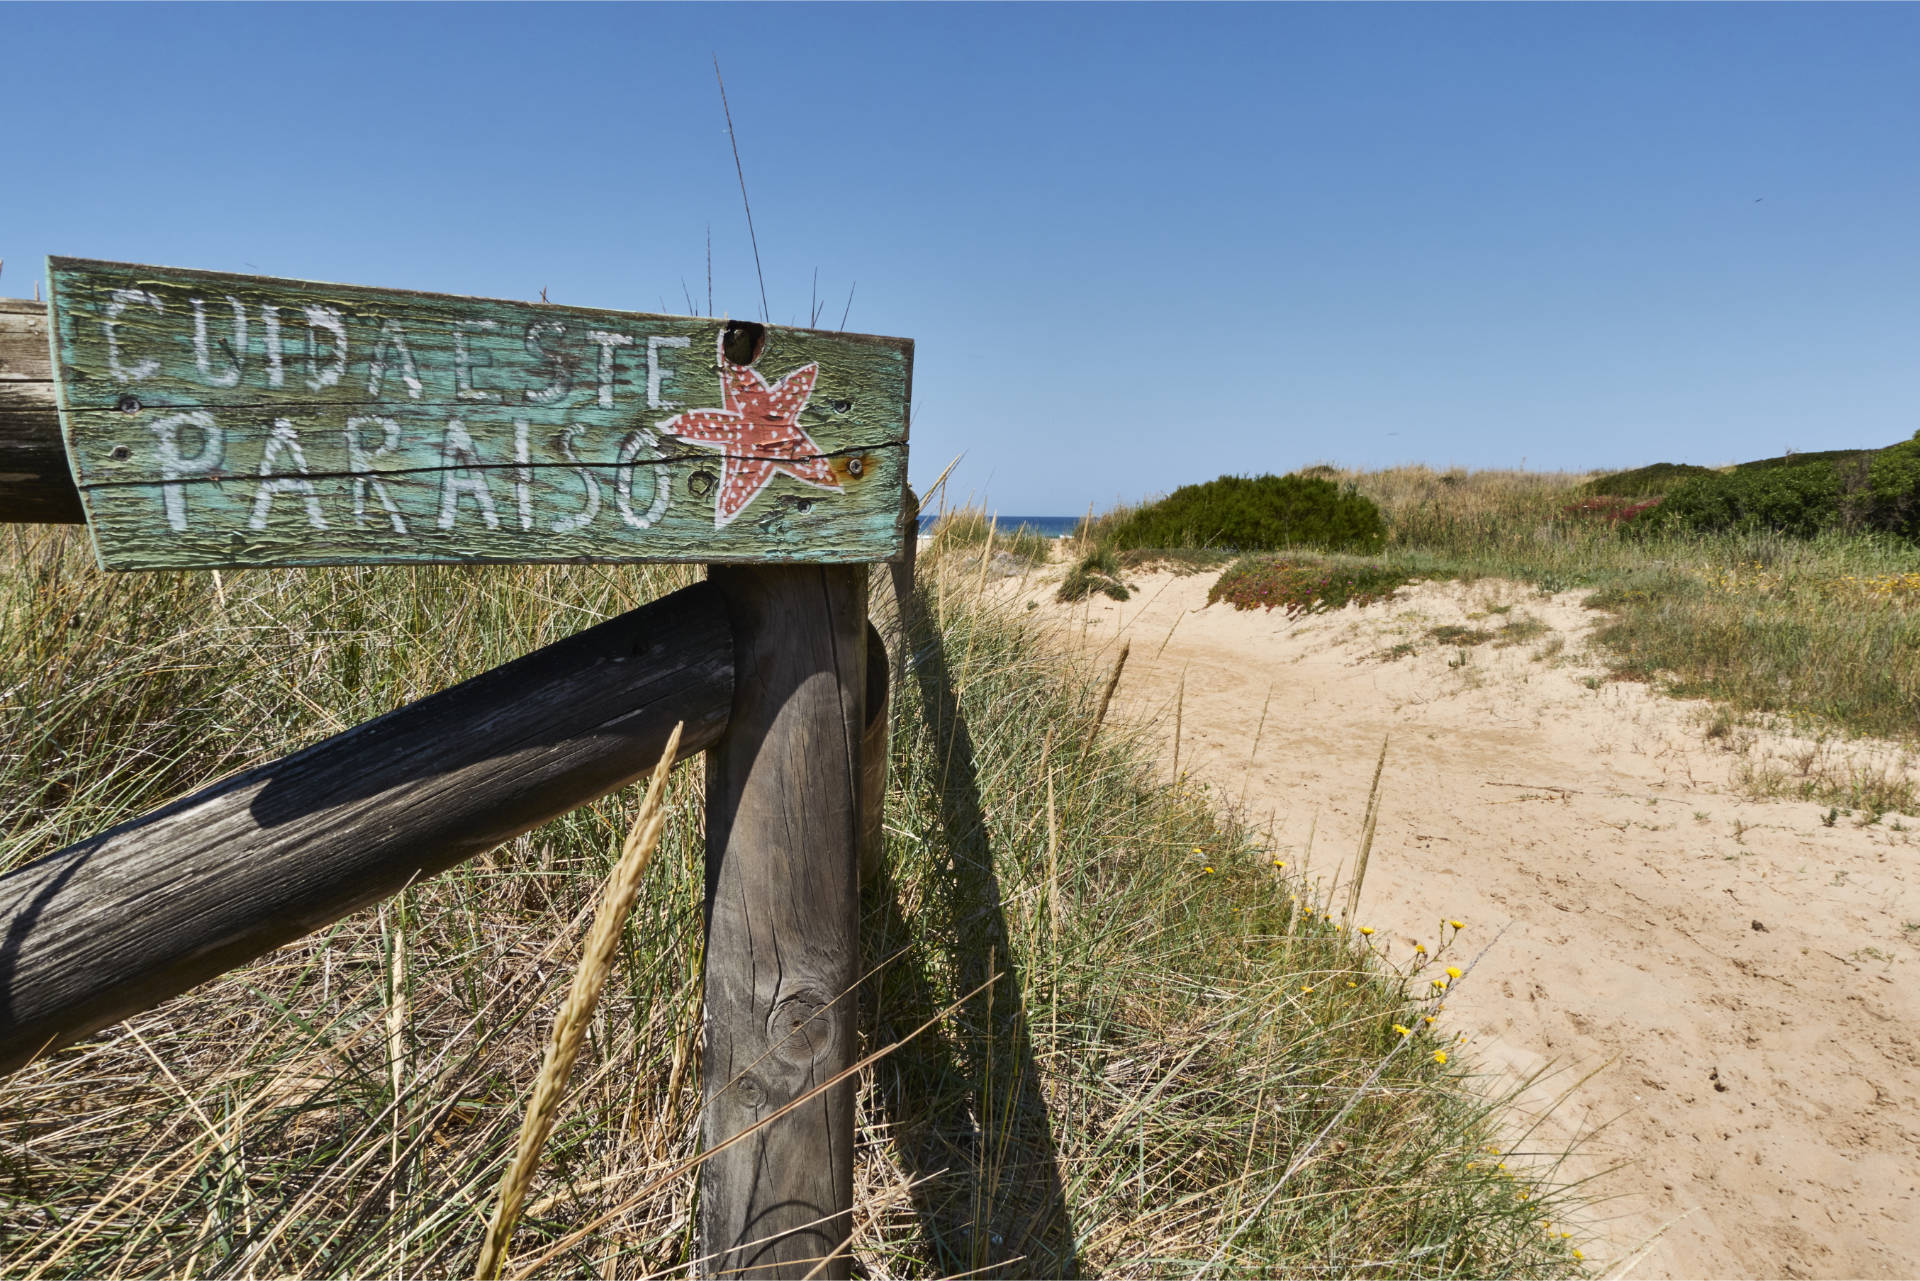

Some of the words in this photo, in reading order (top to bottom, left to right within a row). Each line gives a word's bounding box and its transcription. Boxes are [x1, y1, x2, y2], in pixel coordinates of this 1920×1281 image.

[103, 288, 423, 400] CUIDA
[453, 318, 691, 410] ESTE
[149, 410, 671, 534] PARAISO
